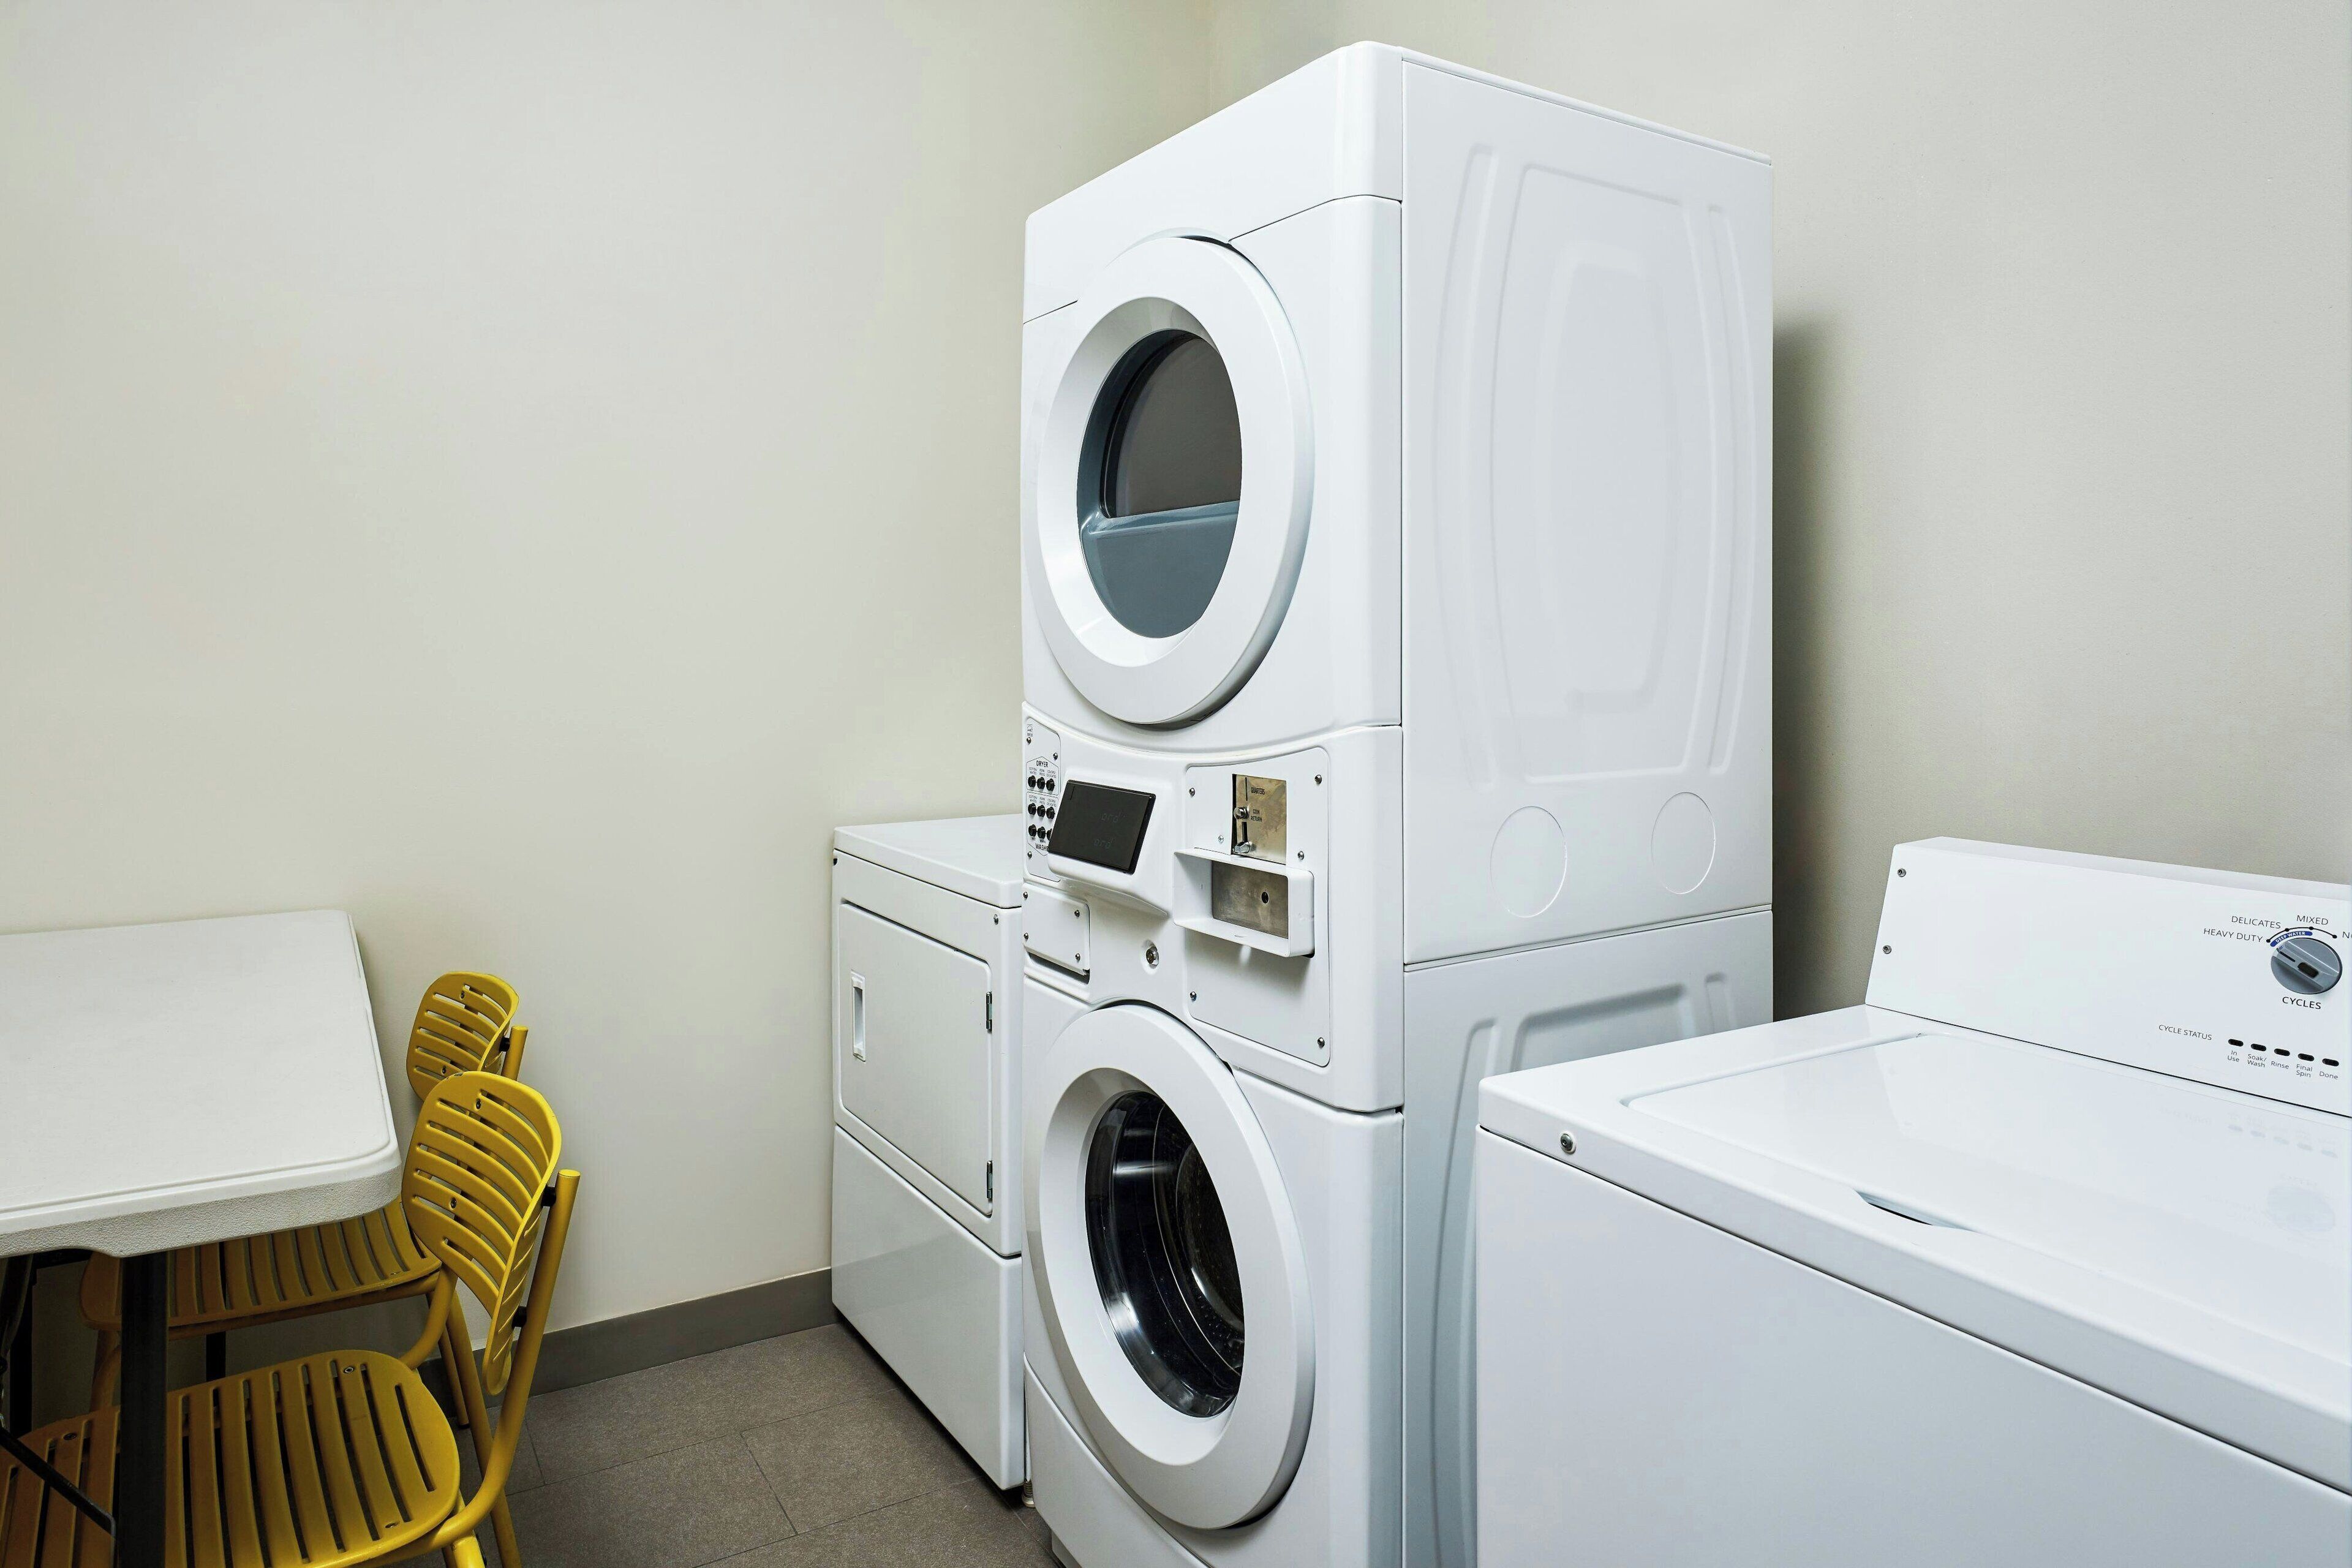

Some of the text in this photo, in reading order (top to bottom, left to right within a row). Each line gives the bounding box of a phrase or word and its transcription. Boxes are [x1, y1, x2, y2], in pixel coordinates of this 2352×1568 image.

[1251, 786, 1265, 795] QUARTERS
[1035, 843, 1049, 852] WASHE
[2231, 916, 2281, 929] DELICATES
[2296, 914, 2329, 925] MIXED
[2203, 928, 2263, 943] HEAVY DUTY
[2275, 935, 2287, 943] DEEP
[2282, 996, 2322, 1010] CYCLES
[2158, 1024, 2212, 1041] CYCLE STATUS
[2247, 1054, 2267, 1062] Soak/
[2271, 1061, 2290, 1069] Rinse
[2296, 1063, 2313, 1072] Final
[2319, 1071, 2339, 1080] Done
